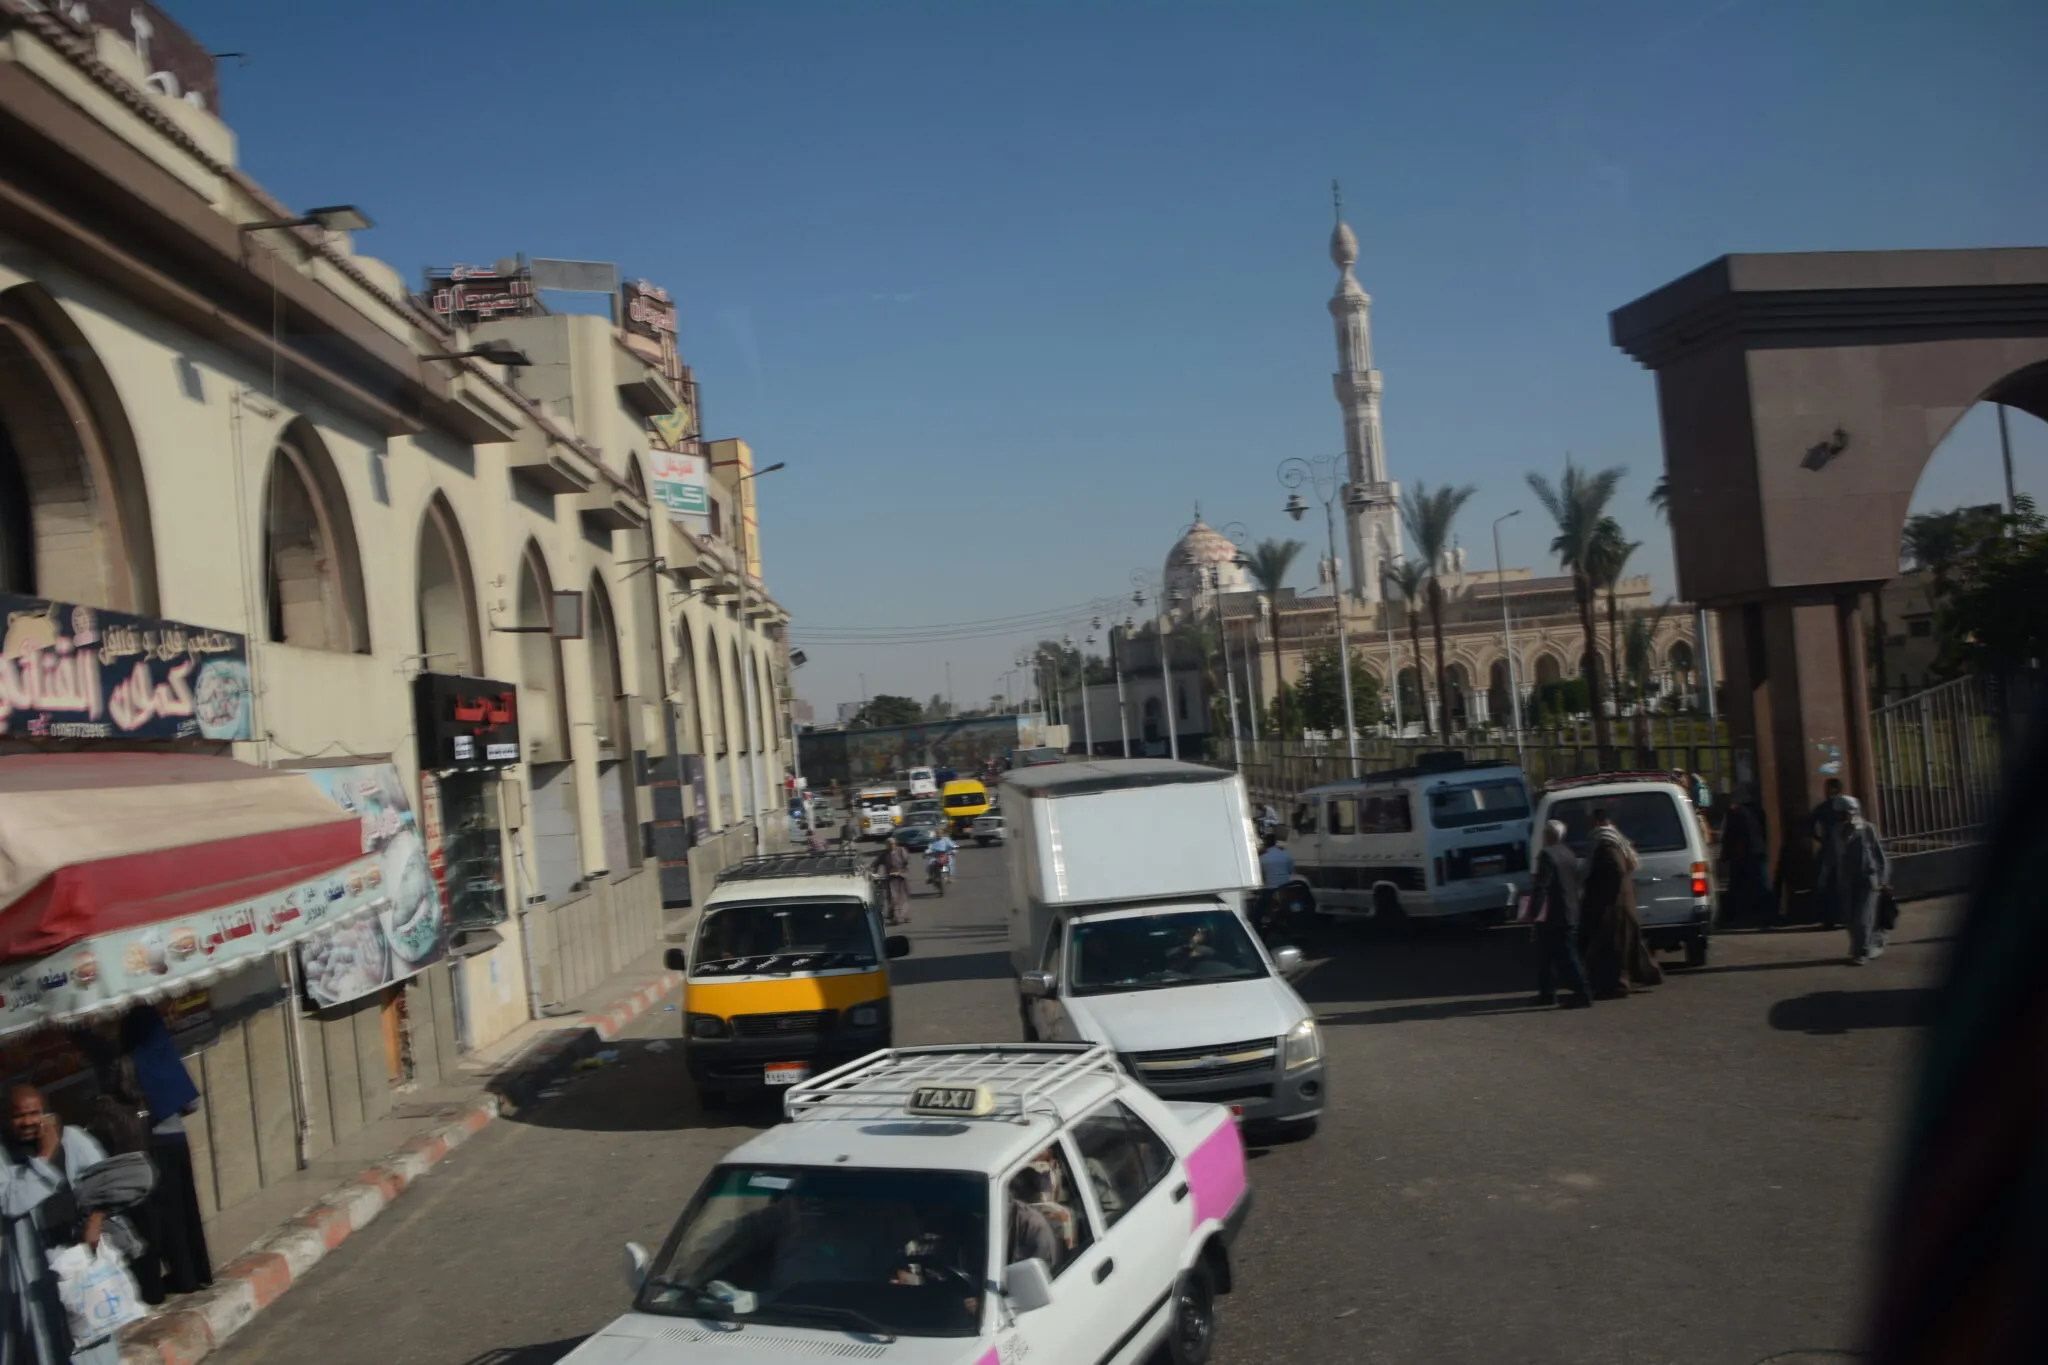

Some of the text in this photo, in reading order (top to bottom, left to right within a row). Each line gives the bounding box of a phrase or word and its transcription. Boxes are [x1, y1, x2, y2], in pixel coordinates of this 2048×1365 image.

[99, 624, 142, 666] فلافل
[157, 625, 186, 662] فول
[187, 629, 234, 667] مطعم
[917, 1089, 972, 1109] TAXI
